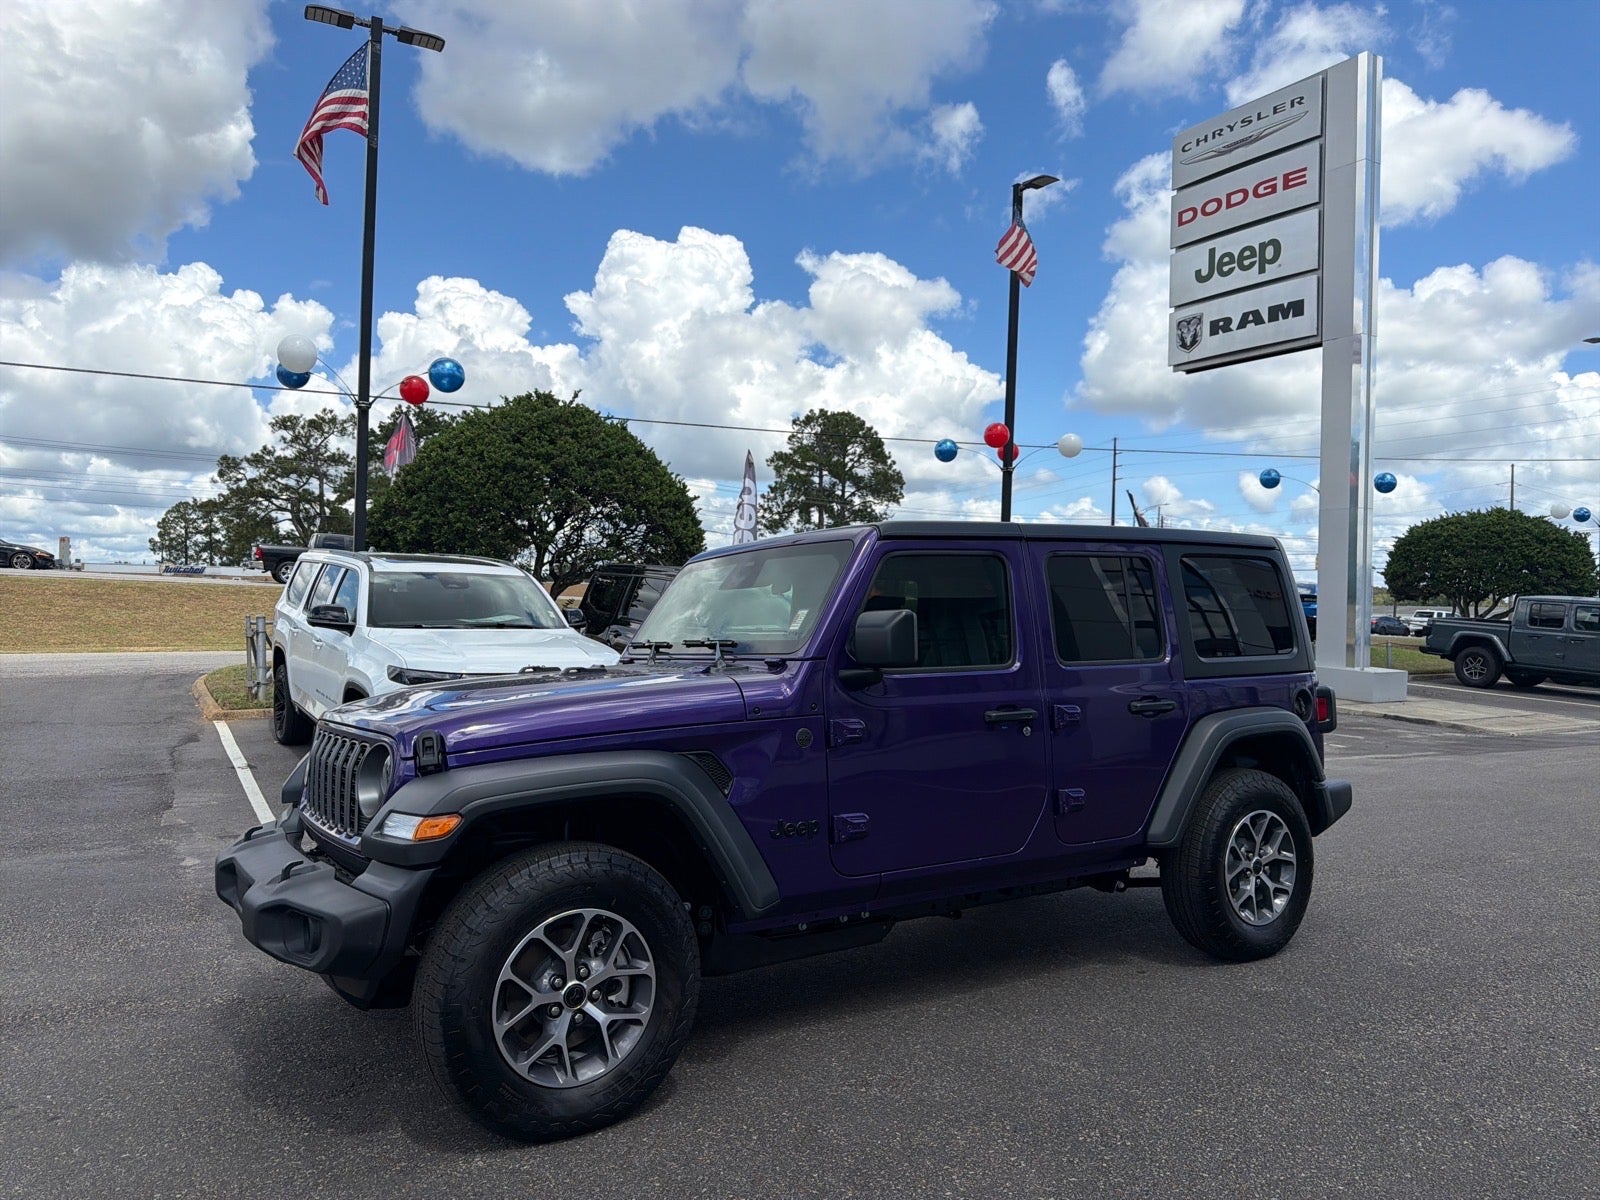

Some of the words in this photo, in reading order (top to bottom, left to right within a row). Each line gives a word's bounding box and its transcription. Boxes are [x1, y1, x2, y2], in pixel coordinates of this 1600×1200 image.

[1181, 96, 1305, 153] CHRYSLER
[1177, 166, 1308, 228] DODGE
[1194, 238, 1282, 284] Jeep
[1209, 298, 1305, 337] RAM
[162, 565, 207, 575] Twitchell
[769, 817, 821, 841] Jeep
